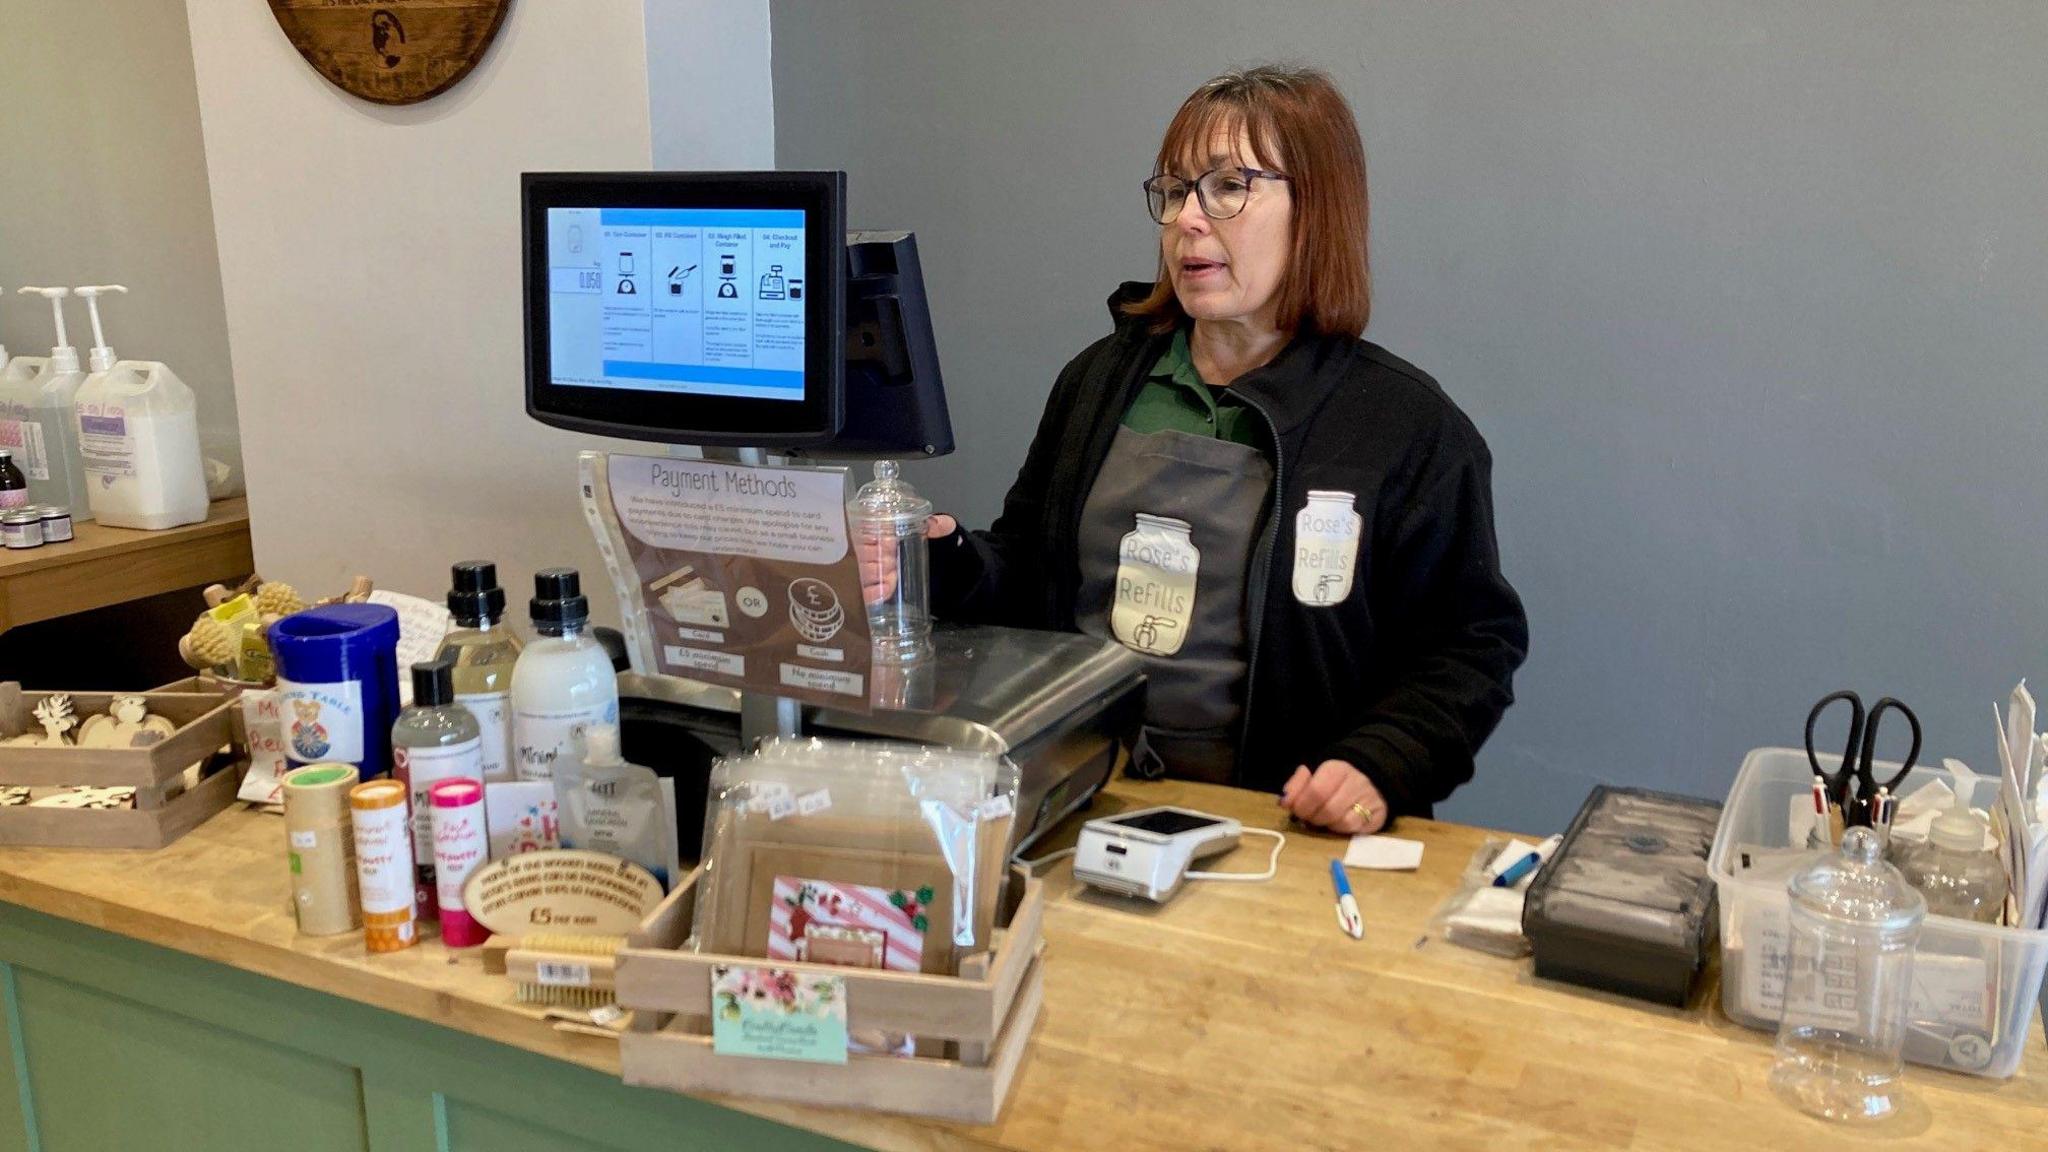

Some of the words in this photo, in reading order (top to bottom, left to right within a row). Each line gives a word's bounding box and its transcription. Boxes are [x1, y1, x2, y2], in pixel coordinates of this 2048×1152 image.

[651, 463, 719, 497] Payment
[725, 471, 797, 498] Methods
[765, 508, 790, 518] spend
[802, 511, 821, 520] card
[1303, 513, 1353, 536] Rose's
[1126, 539, 1190, 573] Rose's
[1298, 547, 1348, 570] Refills
[743, 597, 761, 607] OR
[1120, 577, 1185, 614] Refills
[692, 650, 732, 665] minimum
[529, 907, 552, 925] £5
